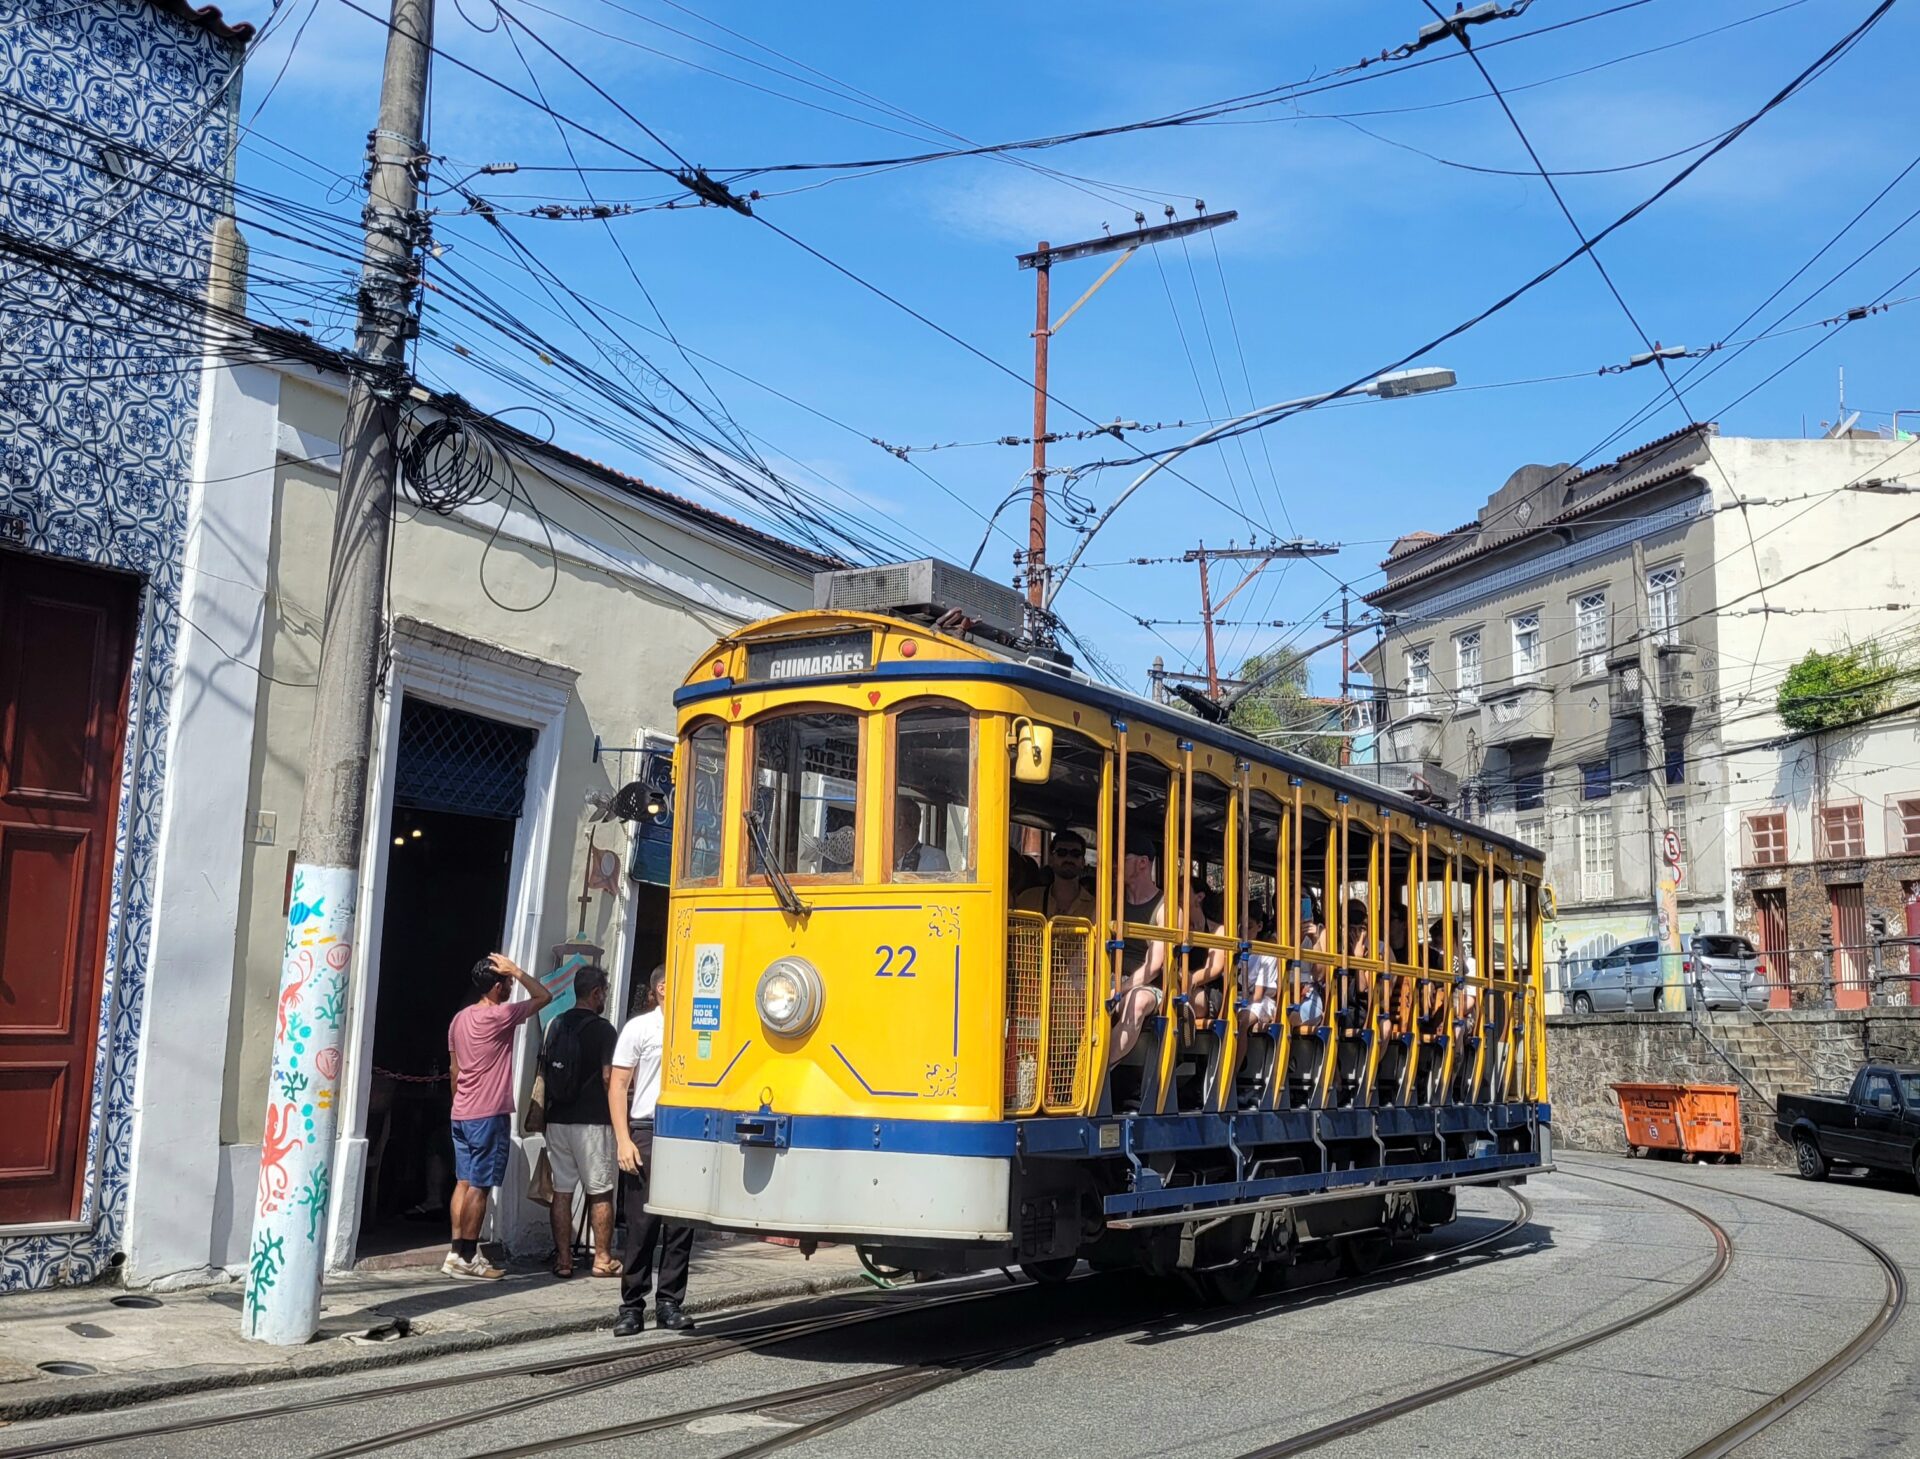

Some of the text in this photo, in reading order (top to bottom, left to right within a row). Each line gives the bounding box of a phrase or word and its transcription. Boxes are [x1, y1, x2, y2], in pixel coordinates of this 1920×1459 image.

[769, 649, 865, 679] GUIMARÃES
[875, 945, 917, 977] 22
[693, 1009, 713, 1017] RIO DE
[693, 1017, 718, 1026] JANEIRO
